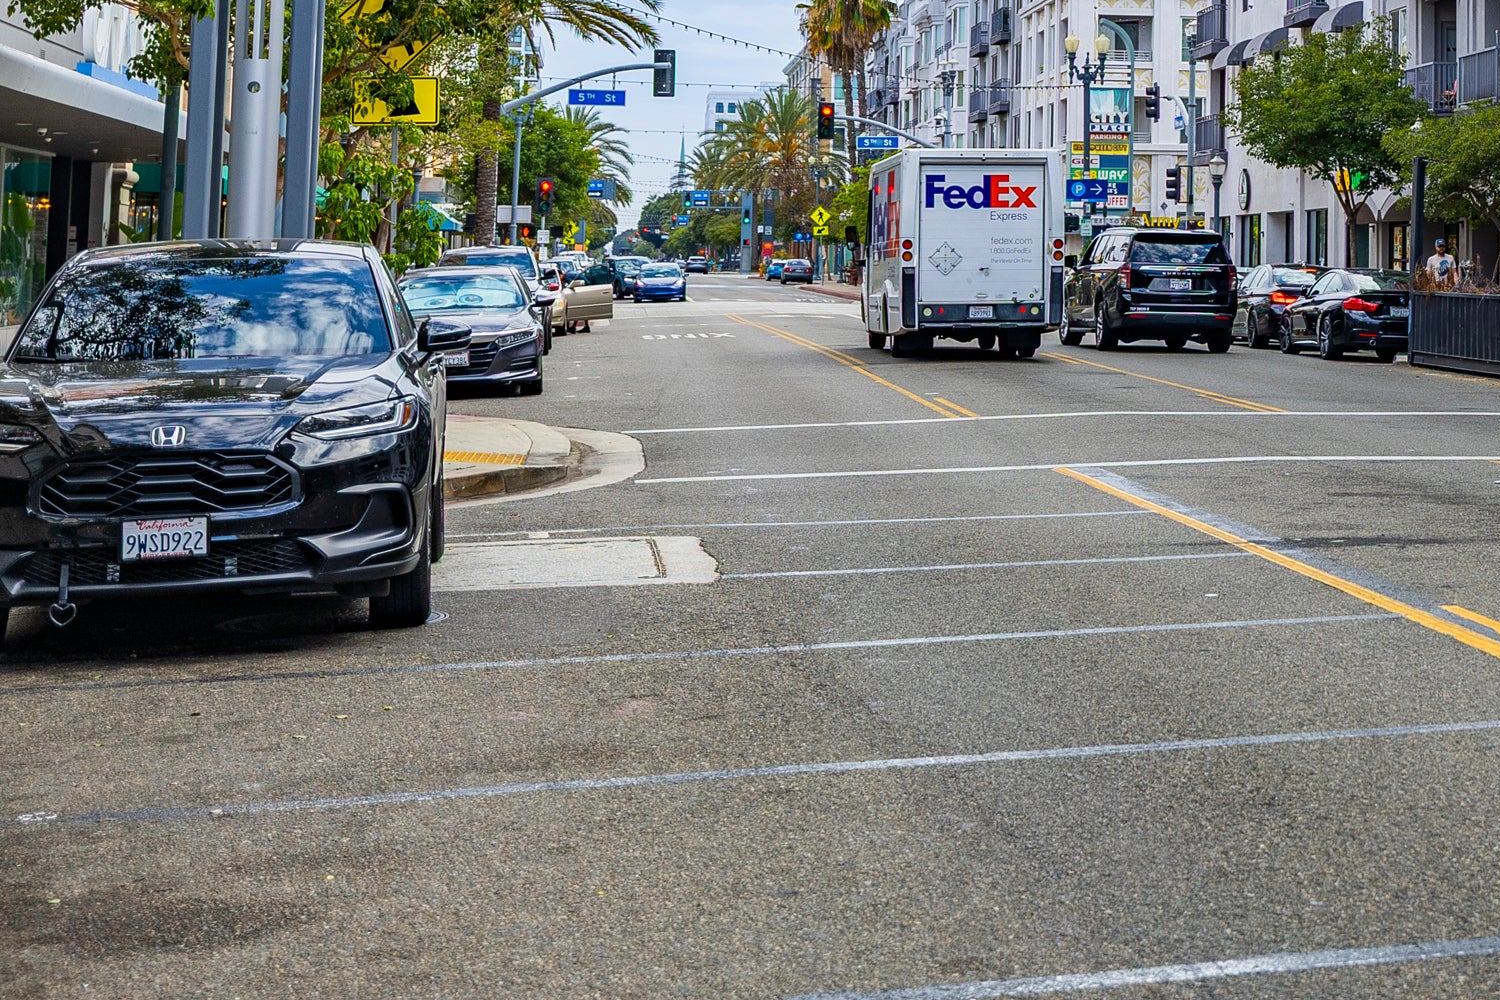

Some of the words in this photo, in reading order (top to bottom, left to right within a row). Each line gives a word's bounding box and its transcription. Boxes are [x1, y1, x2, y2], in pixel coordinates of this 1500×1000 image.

[604, 93, 617, 103] St
[1090, 112, 1129, 123] CITY
[1090, 124, 1129, 132] PLACE
[883, 139, 893, 147] St
[1072, 170, 1128, 180] SBWAY
[925, 174, 1038, 210] FedEx
[1103, 196, 1128, 206] UFFET
[990, 211, 1028, 222] Express
[1141, 213, 1181, 230] Army
[990, 236, 1033, 245] fedex.com
[139, 519, 194, 532] California
[126, 530, 204, 555] 9WSD922
